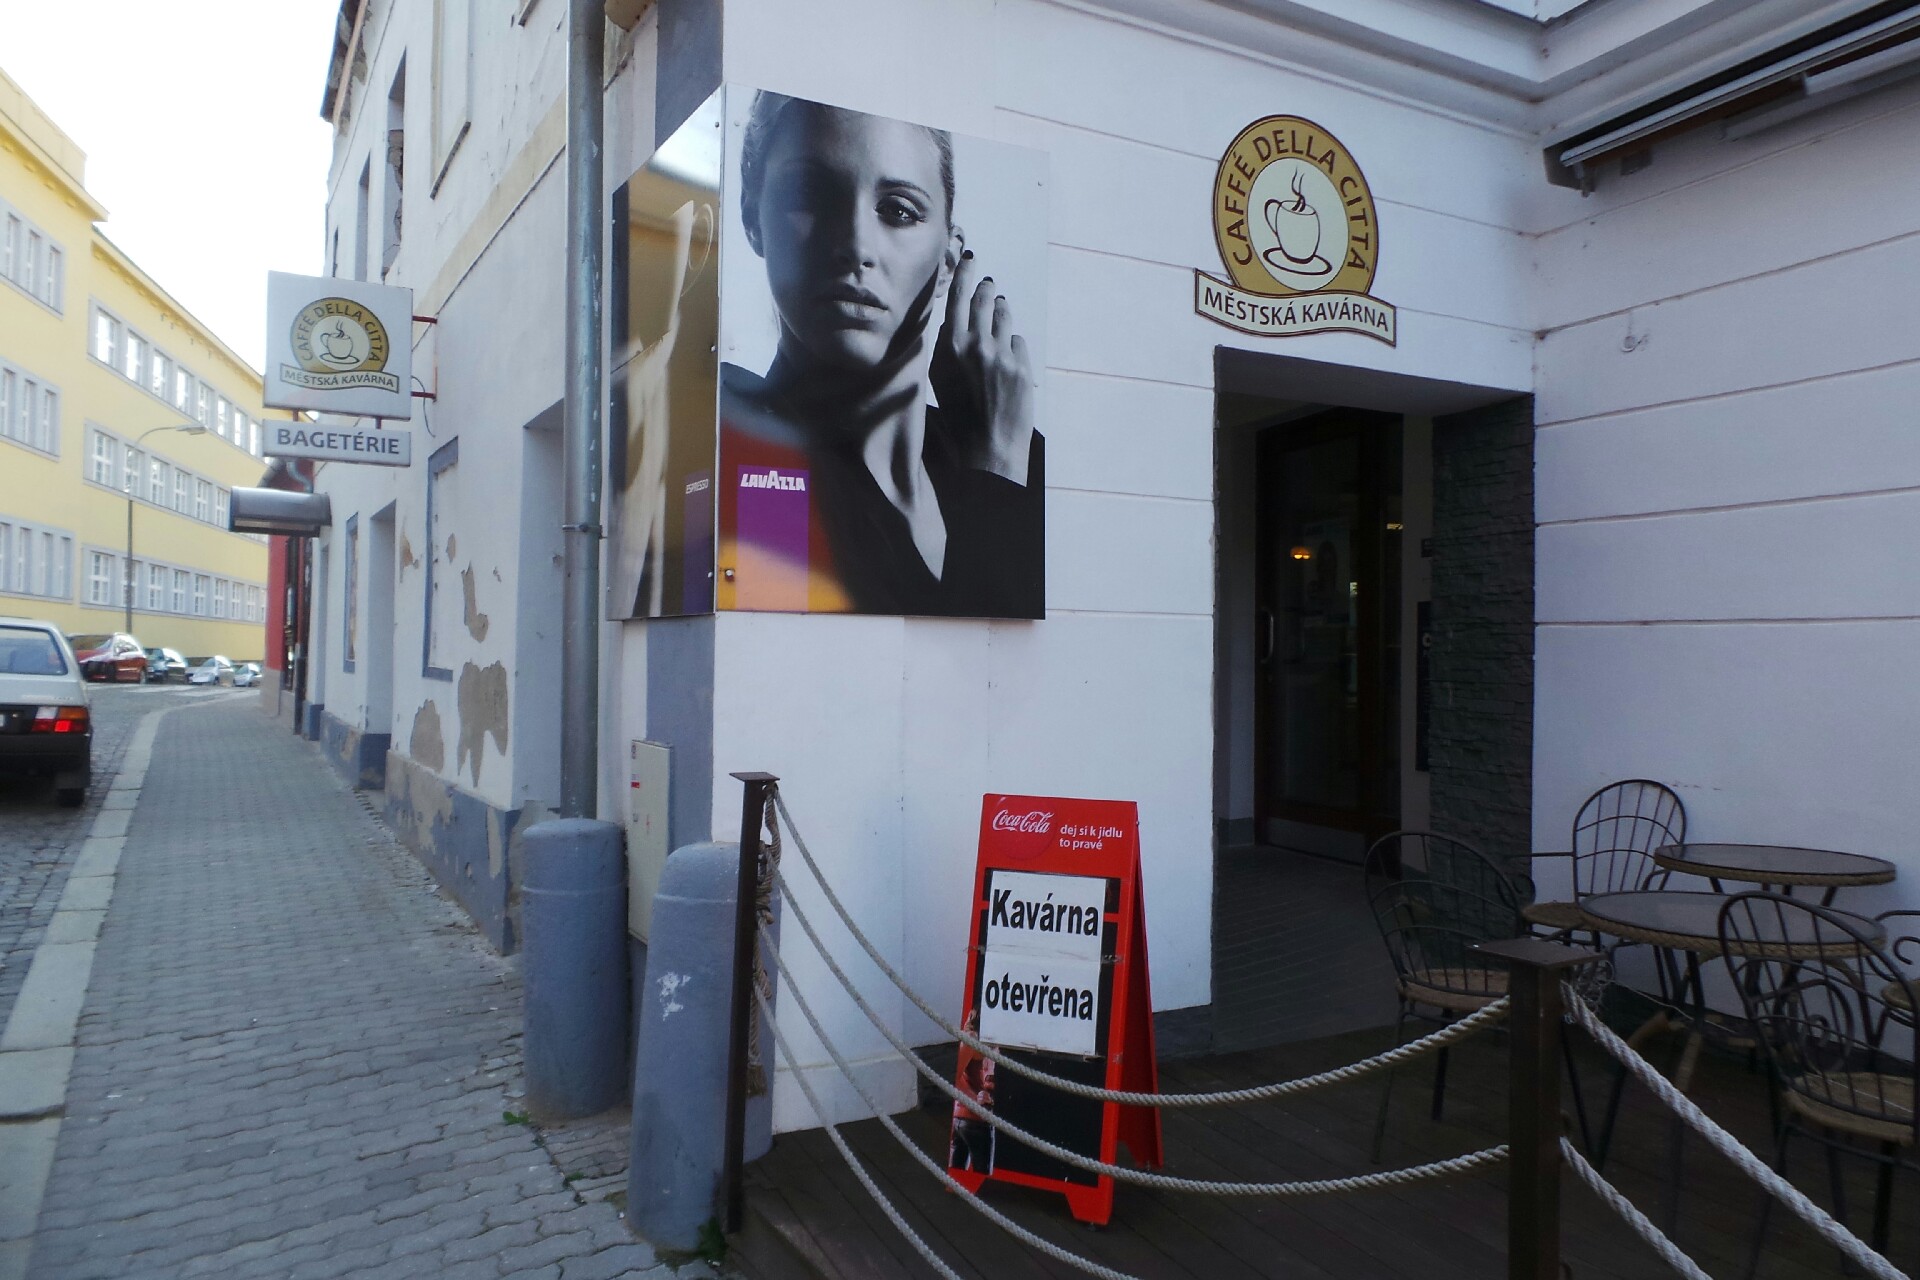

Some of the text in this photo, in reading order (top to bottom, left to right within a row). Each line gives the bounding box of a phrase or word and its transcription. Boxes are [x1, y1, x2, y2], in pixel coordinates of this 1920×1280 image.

[1252, 129, 1337, 174] DELLA
[313, 303, 362, 322] DELLA
[1204, 286, 1389, 332] MĚSTSKÁ KAVÁRNA
[341, 373, 394, 388] KAVÁRNA
[277, 428, 400, 455] BAGETÉRIE
[740, 470, 806, 492] LAVAZZA
[992, 809, 1055, 834] Coca-Cola
[1060, 825, 1077, 837] dej
[1079, 826, 1088, 836] si
[1089, 826, 1097, 836] k
[1059, 838, 1103, 851] to pravé
[991, 889, 1099, 937] Kavárna
[985, 972, 1094, 1021] otevřena
